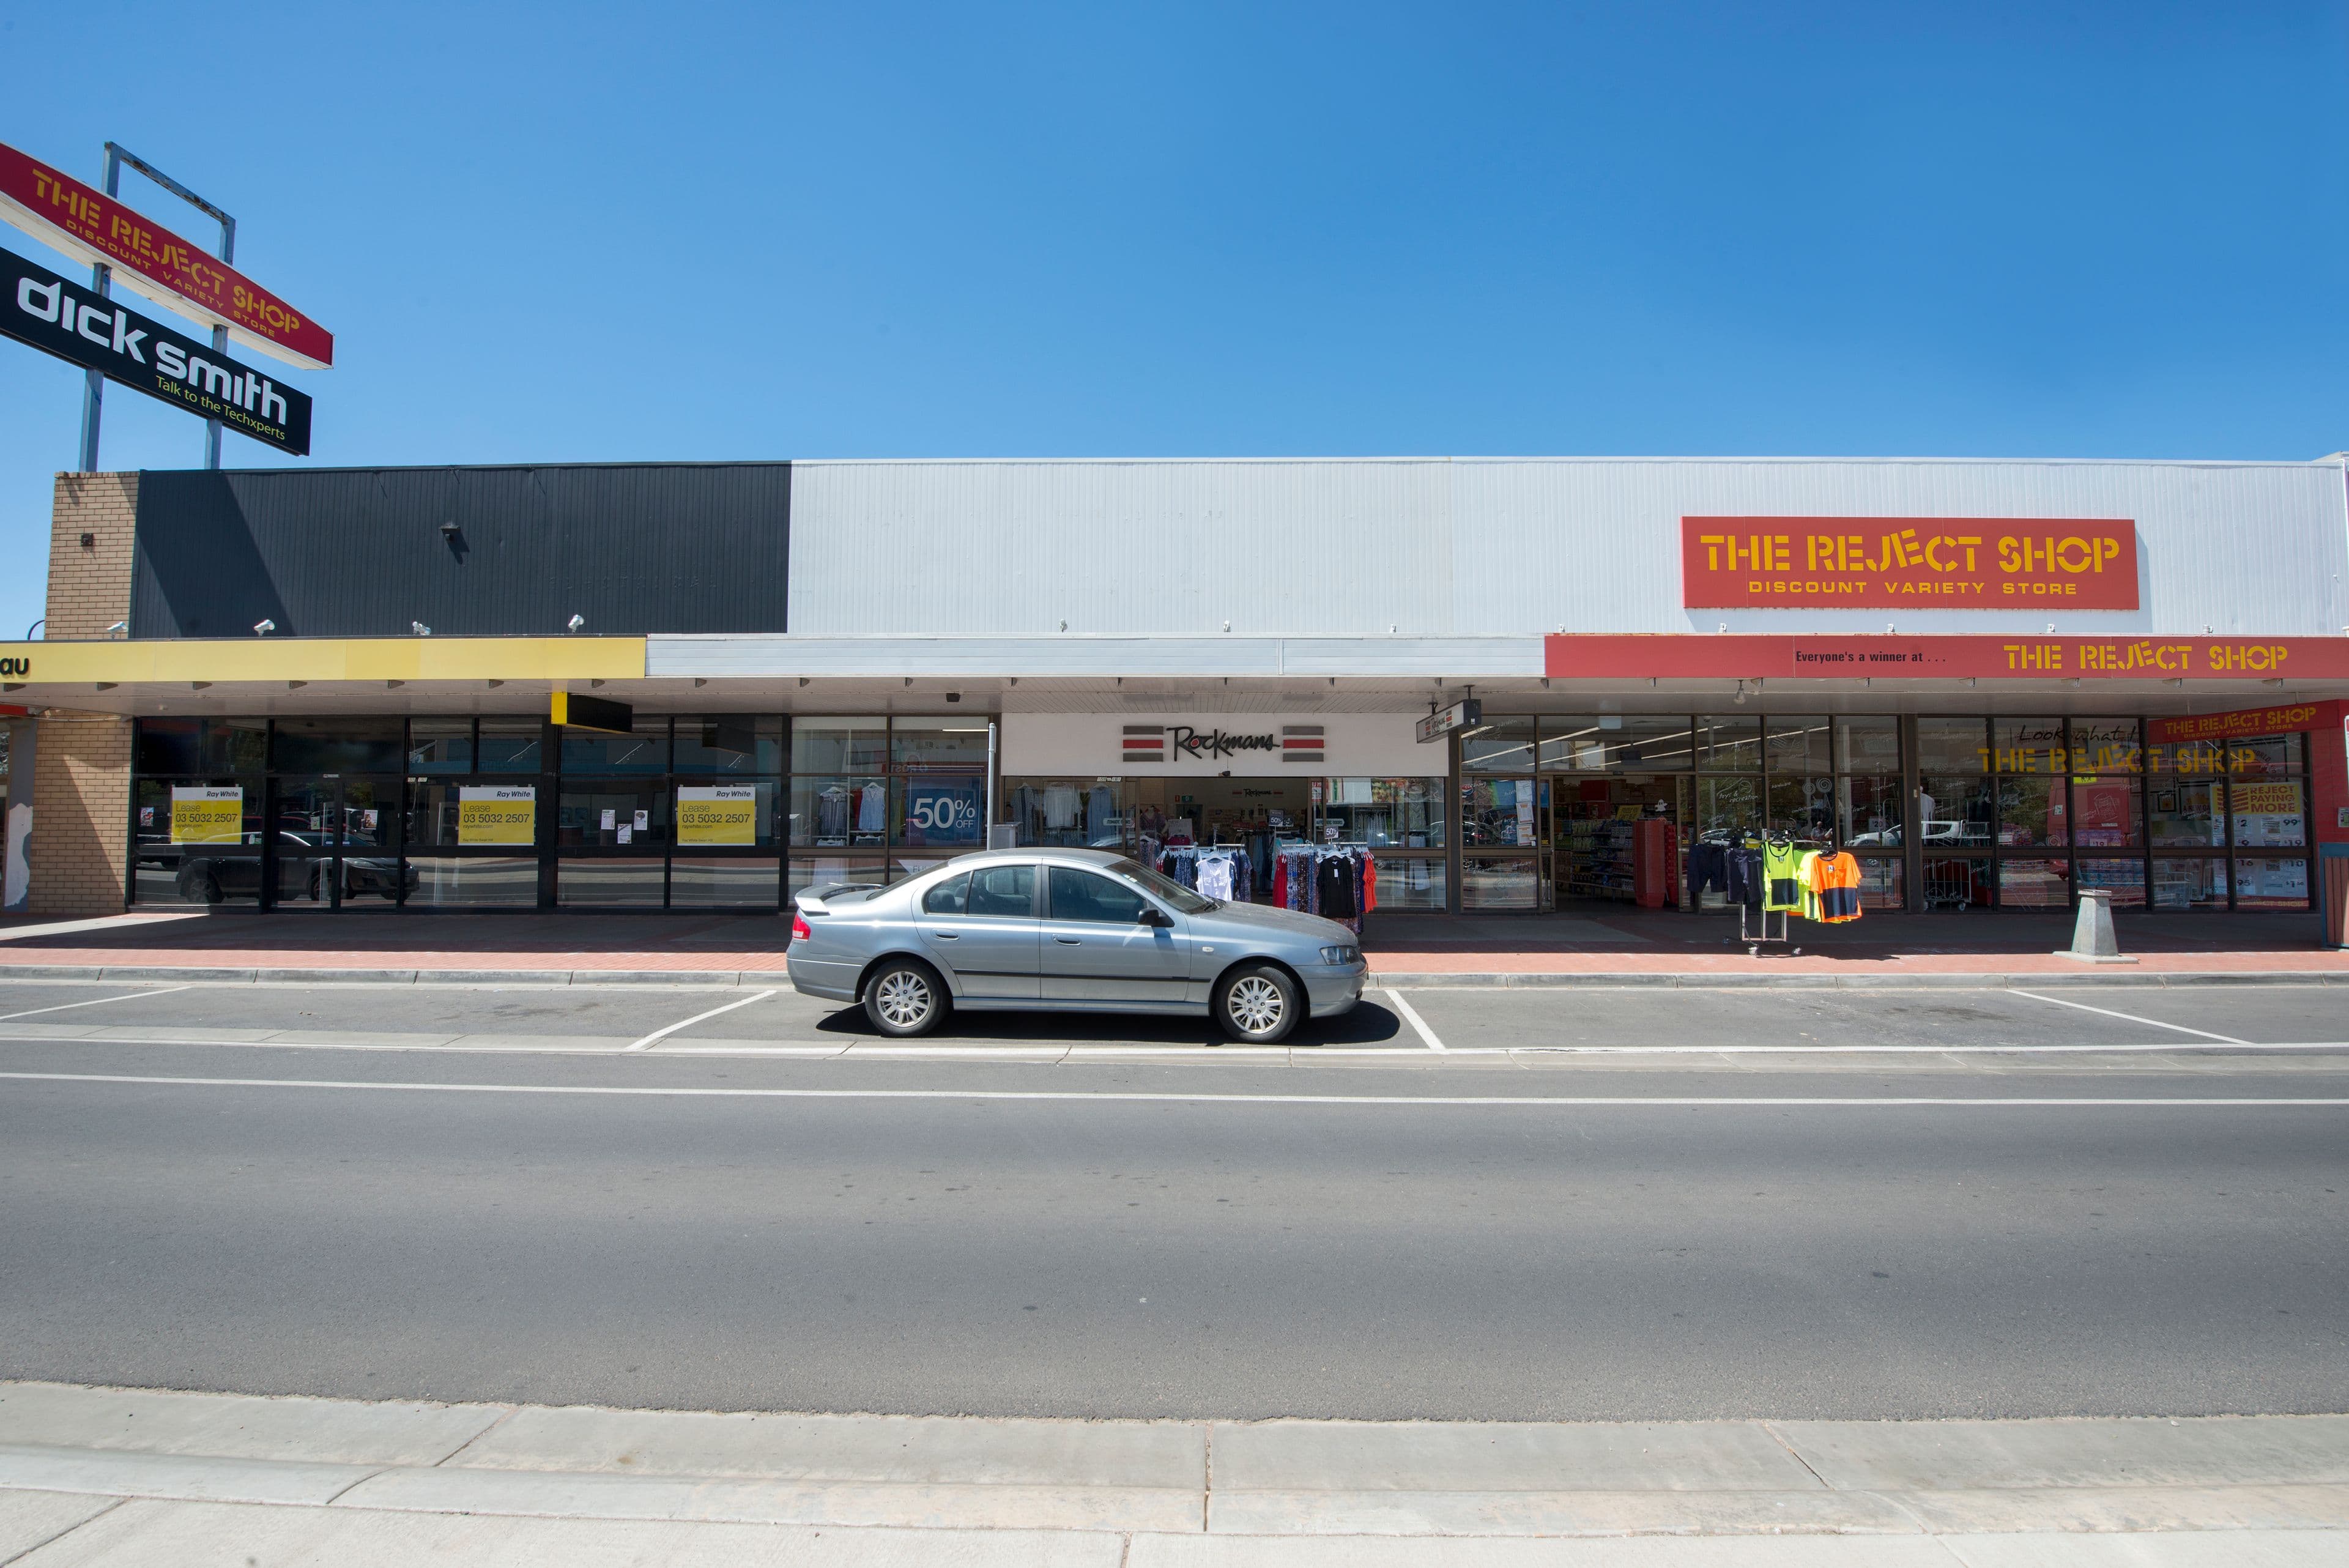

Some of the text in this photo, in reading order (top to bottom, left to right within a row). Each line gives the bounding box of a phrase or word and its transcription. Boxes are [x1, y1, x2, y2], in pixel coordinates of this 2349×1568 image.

[32, 169, 300, 334] THE REJECT SHOP
[66, 220, 275, 338] DISCOUNT VARIETY STORE
[18, 278, 287, 425] dick smith
[156, 375, 286, 440] Talk to the Techxperts
[1700, 528, 2120, 573] THE REJECT SHOP
[1749, 581, 2077, 596] DISCOUNT VARIETY STORE
[1796, 650, 1854, 667] Everyone's
[1858, 654, 1865, 663] a
[1869, 651, 1908, 663] winner
[1911, 652, 1923, 663] at
[2004, 641, 2288, 671] THE REJECT SHOP
[2165, 707, 2317, 735] THE REJECT SHOP
[2019, 724, 2066, 741] Look
[2074, 726, 2121, 741] what
[1166, 726, 1280, 762] Rockmans
[1977, 748, 2036, 773] THE
[2050, 743, 2163, 773] REJECT
[2176, 748, 2257, 773] SHOP
[176, 803, 201, 812] Lease
[464, 803, 491, 812] Lease
[682, 803, 710, 812] Lease
[913, 797, 976, 829] 50%
[2251, 803, 2295, 812] MORE
[176, 814, 237, 822] 03 5032 2507
[463, 814, 530, 823] 03 5032 2507
[682, 814, 750, 823] 03 5032 2507
[956, 820, 974, 828] OFF
